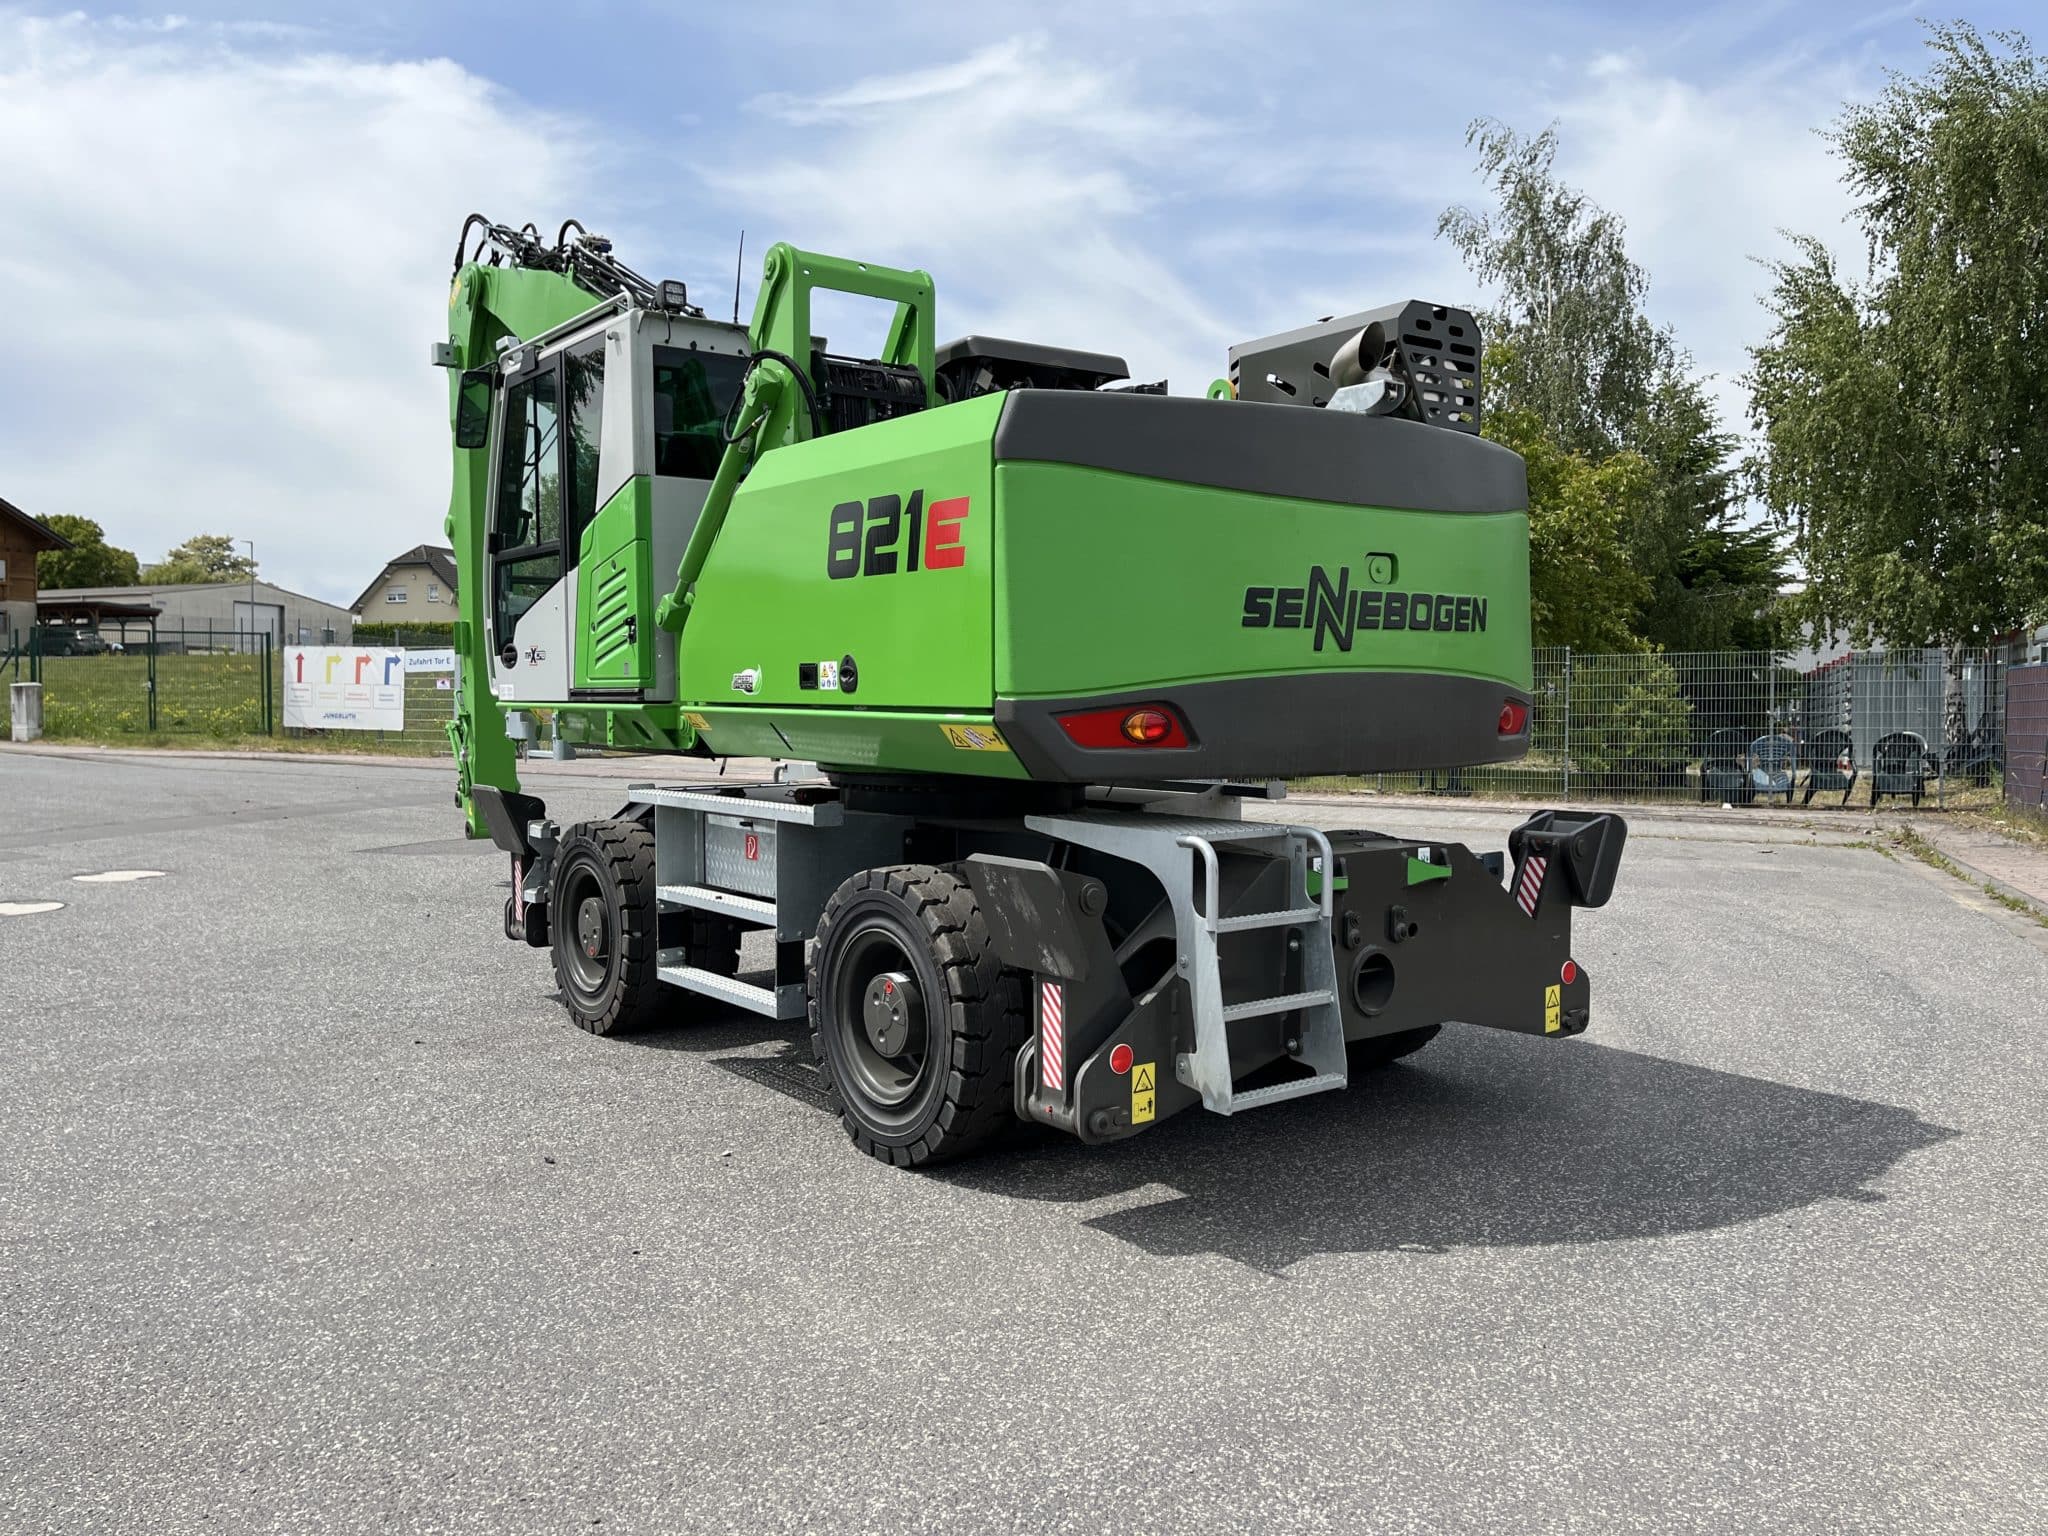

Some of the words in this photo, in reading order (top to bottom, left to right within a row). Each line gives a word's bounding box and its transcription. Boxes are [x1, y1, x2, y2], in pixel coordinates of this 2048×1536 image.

[828, 488, 970, 580] 821E
[1242, 565, 1487, 651] SENNEBOGEN
[434, 657, 445, 665] Tor
